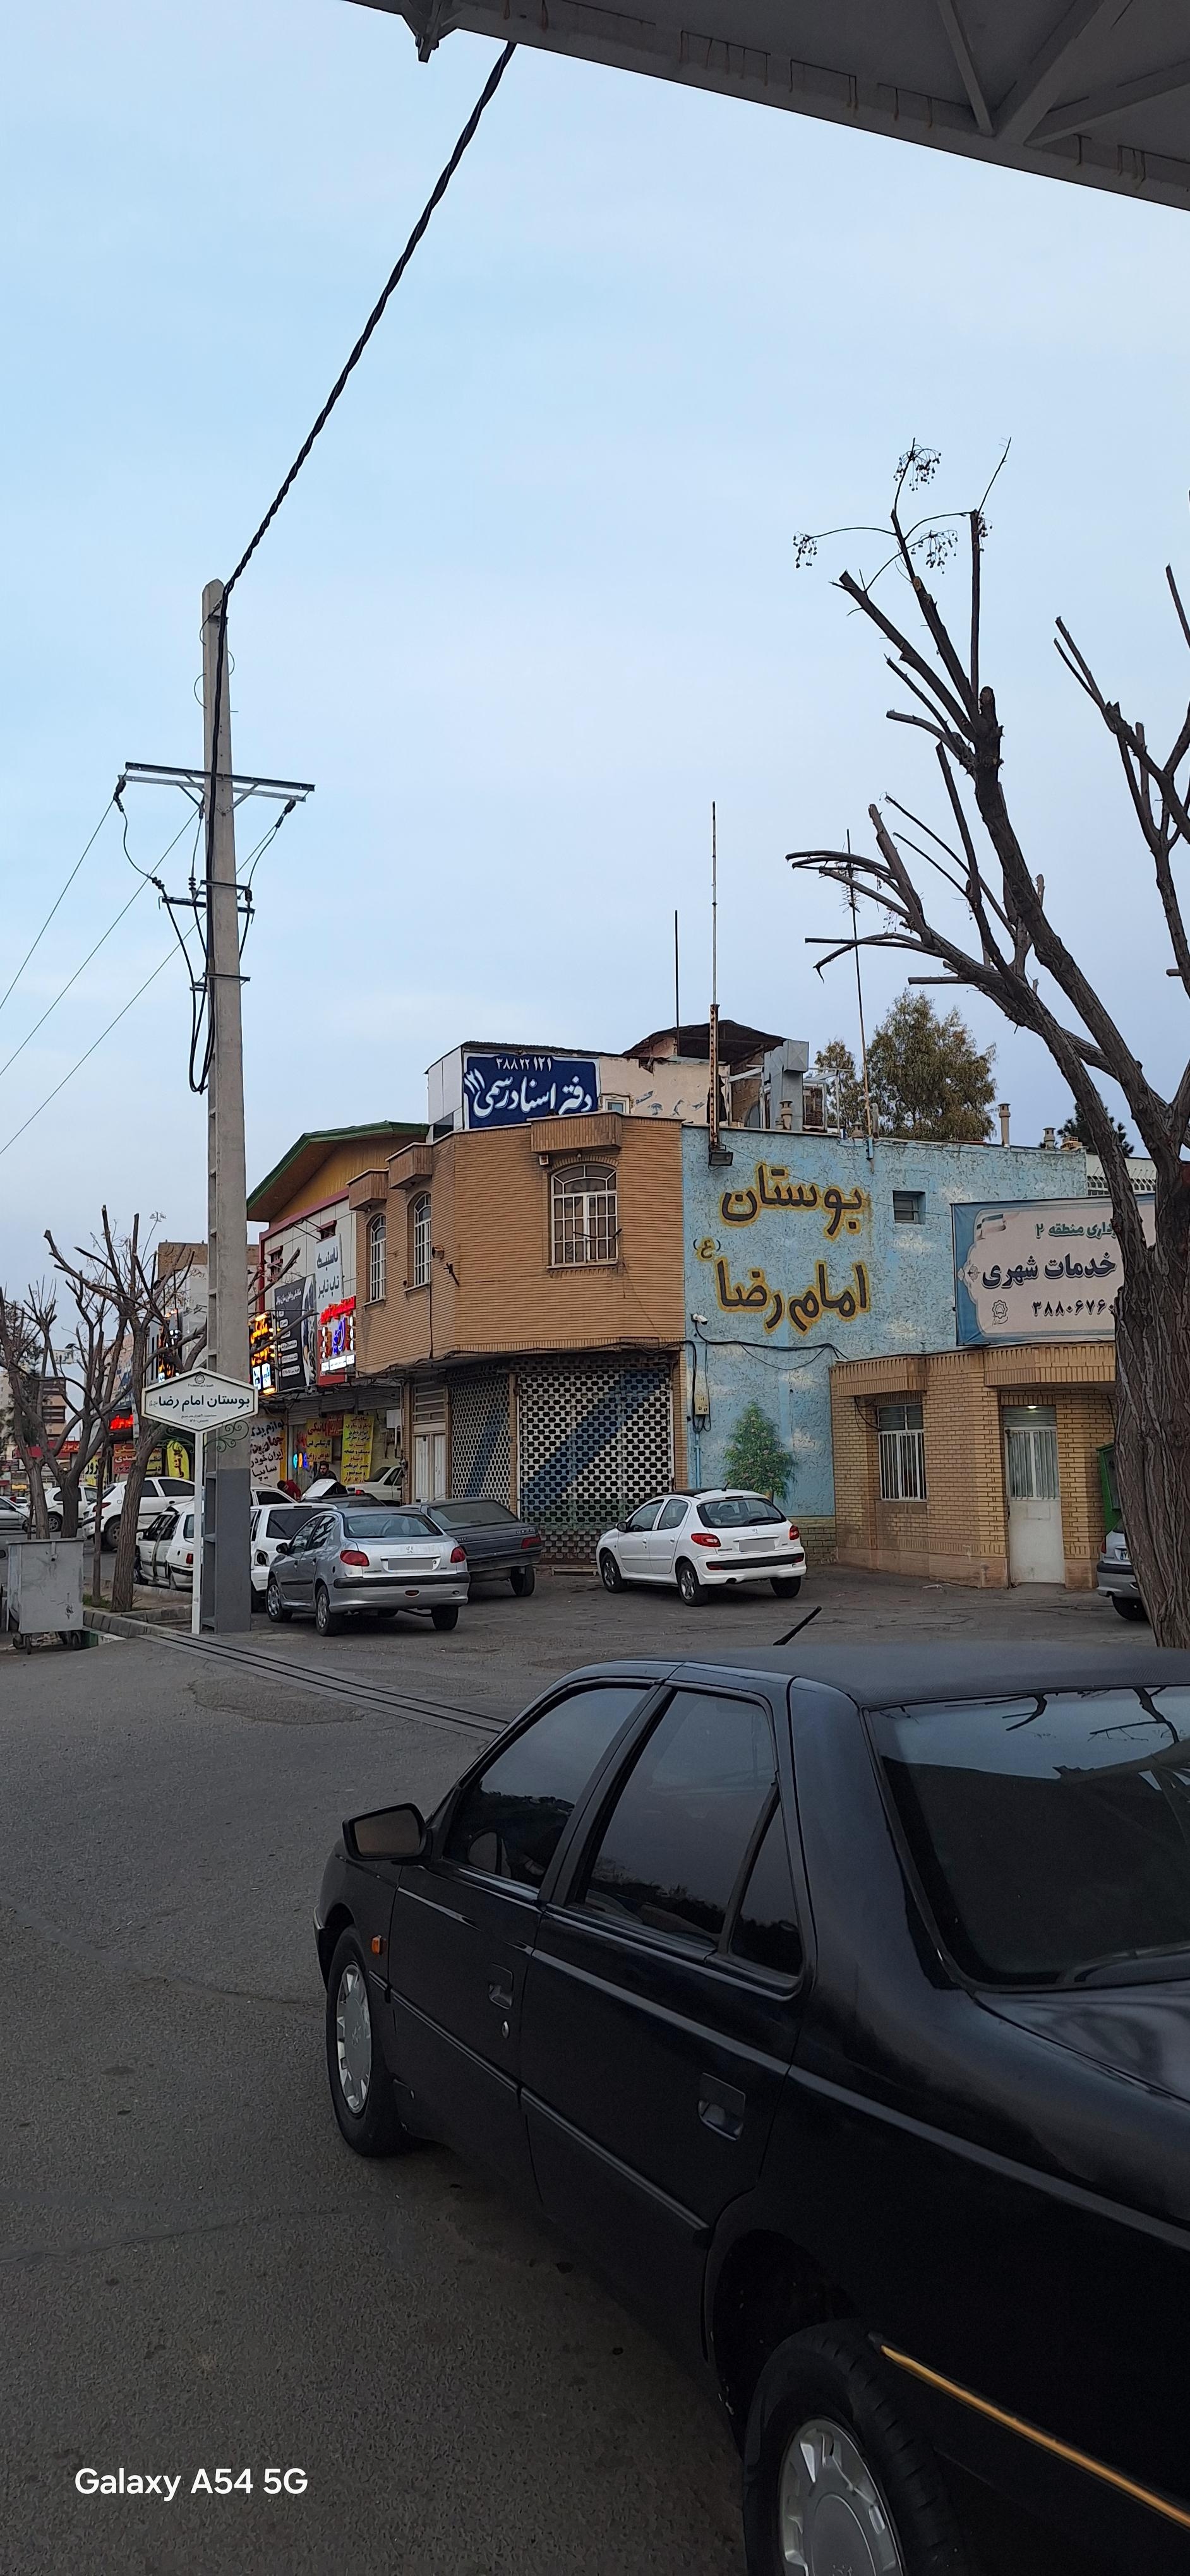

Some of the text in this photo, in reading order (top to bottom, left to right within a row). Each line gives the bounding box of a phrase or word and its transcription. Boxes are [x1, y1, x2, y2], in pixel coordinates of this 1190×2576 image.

[474, 1076, 514, 1118] رسمی
[507, 1076, 556, 1113] اسناد
[558, 1075, 592, 1116] دفتر
[721, 1164, 863, 1237] بوستان
[1036, 1223, 1044, 1239] ۲
[1047, 1223, 1085, 1237] منطقه
[982, 1251, 1117, 1289] خدمات شهری
[716, 1260, 783, 1329] رضا
[790, 1263, 867, 1332] امام
[159, 1395, 179, 1409] رضا
[181, 1395, 204, 1412] امام
[207, 1394, 250, 1409] بوستان
[267, 1419, 285, 1434] لوازم
[250, 1454, 268, 1468] خودر
[268, 1449, 284, 1462] ایران
[252, 1465, 277, 1481] سایپا
